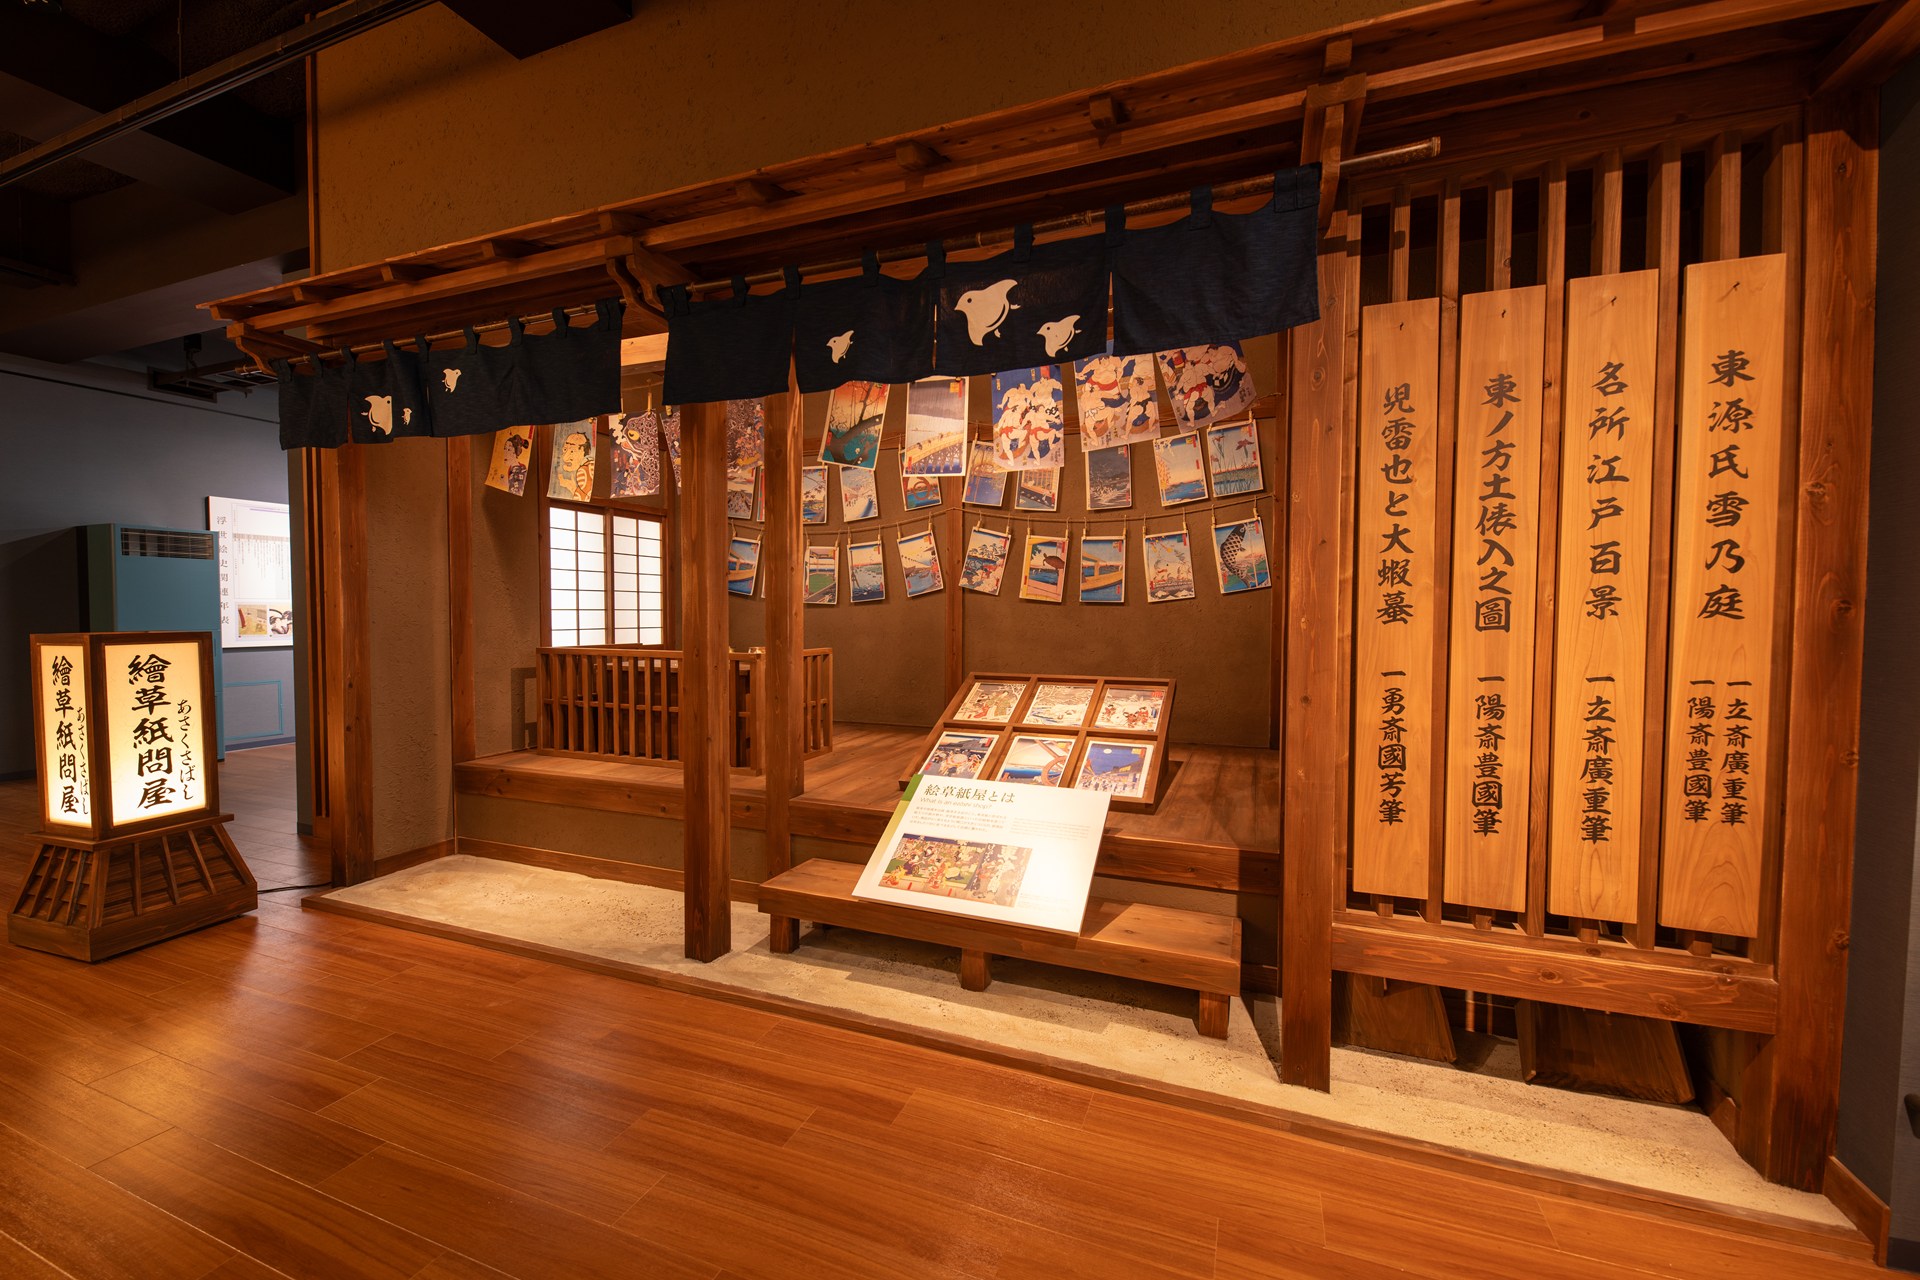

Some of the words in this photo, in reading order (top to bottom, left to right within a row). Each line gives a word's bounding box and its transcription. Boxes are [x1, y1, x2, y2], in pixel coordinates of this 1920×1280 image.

[1586, 361, 1630, 620] 名所江戸百景
[1698, 350, 1755, 620] 東源氏雪乃庭
[52, 655, 79, 814] 繪草紙問屋
[127, 653, 177, 809] 繪草紙問屋
[177, 699, 196, 800] あさくさばし
[924, 783, 1016, 803] 絵草紙屋とは
